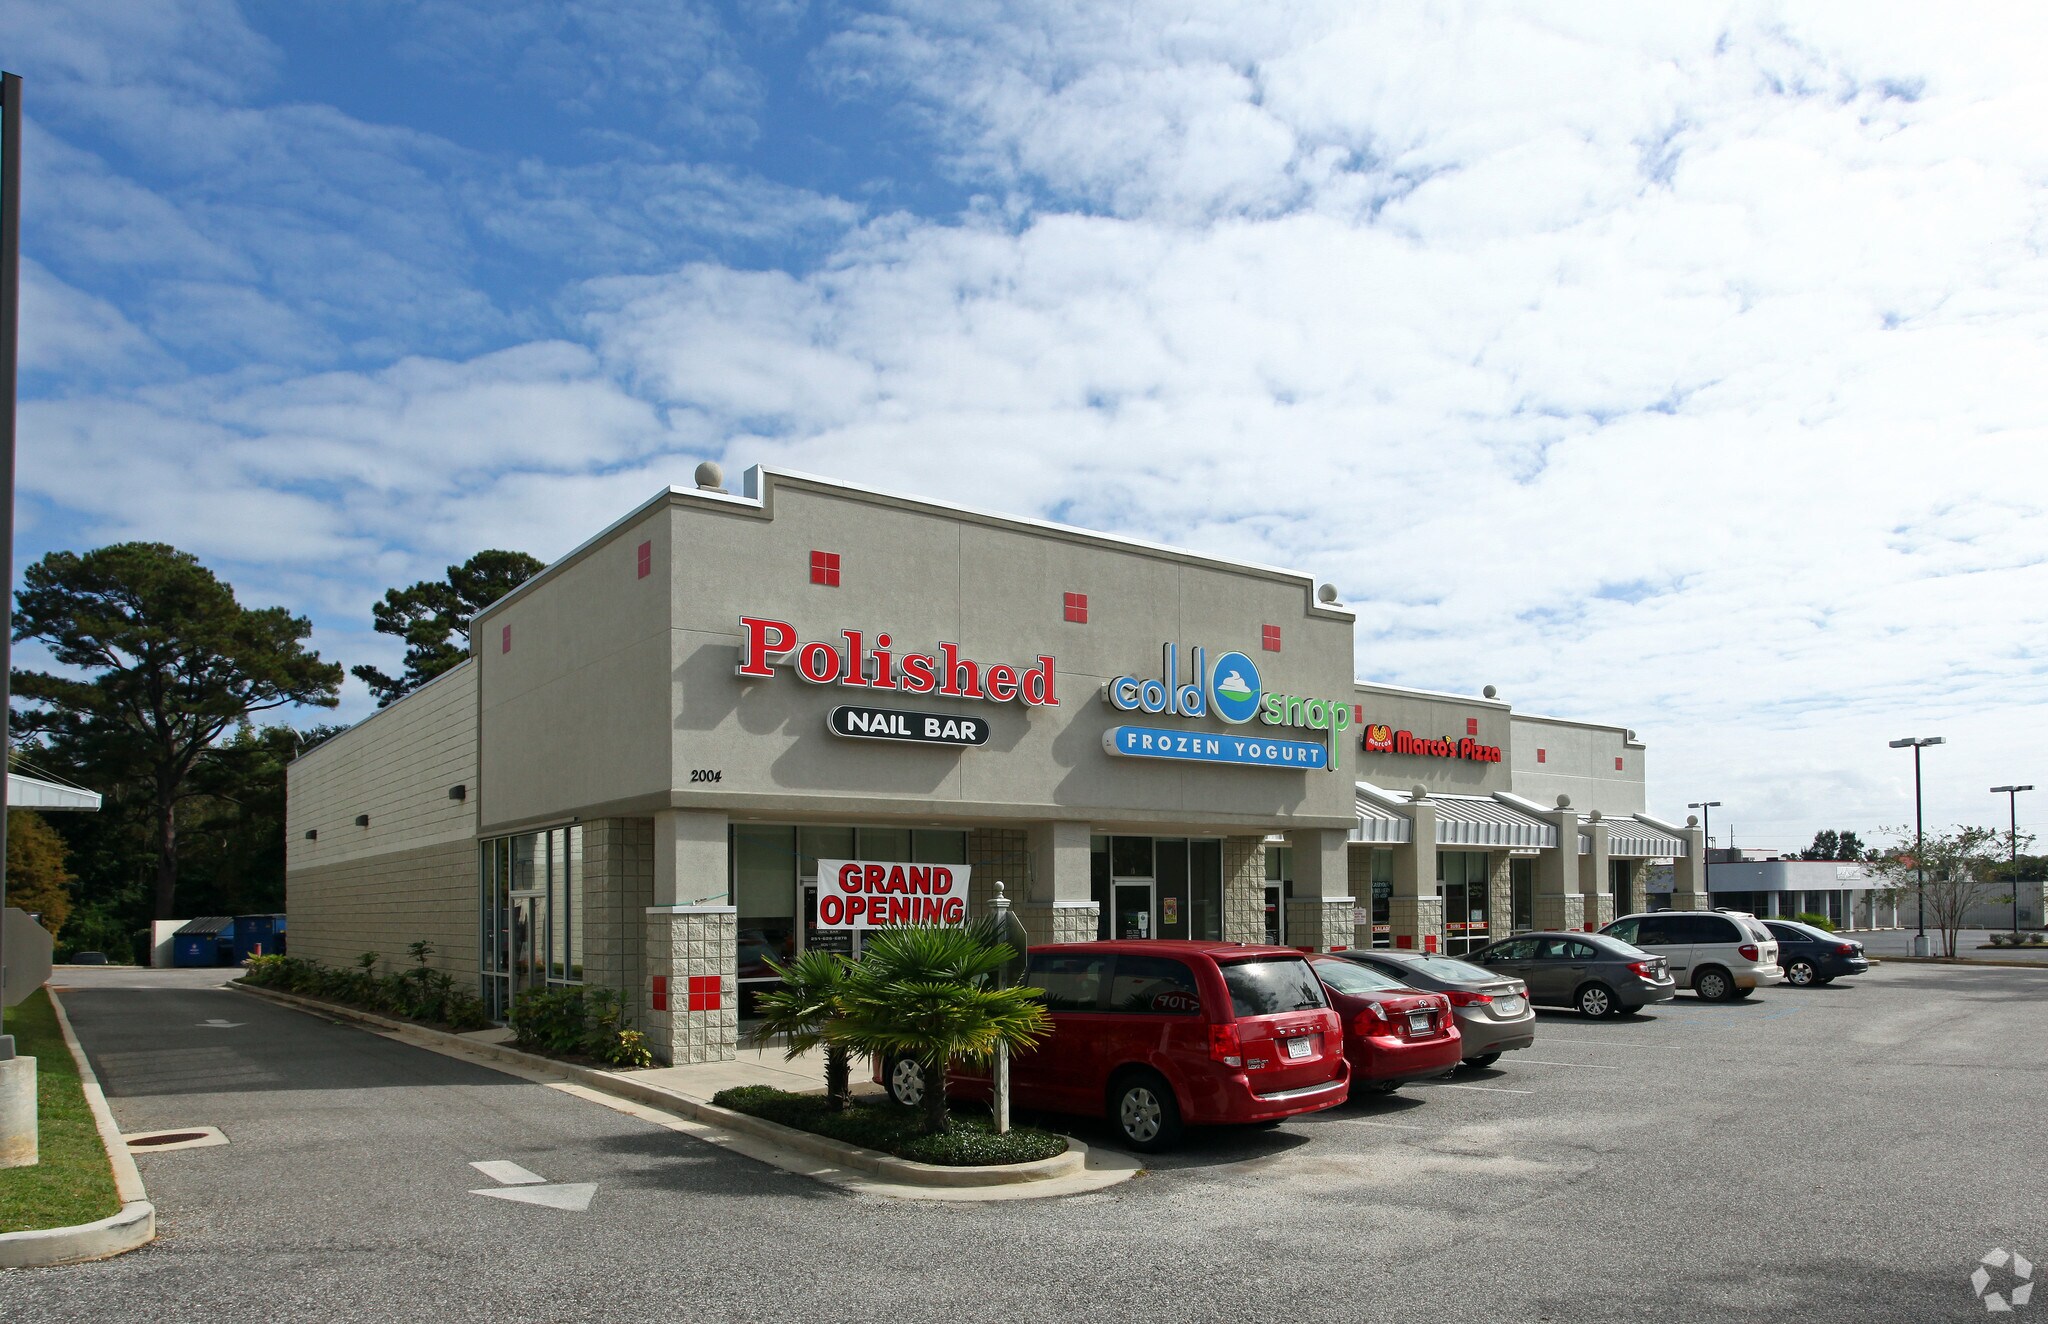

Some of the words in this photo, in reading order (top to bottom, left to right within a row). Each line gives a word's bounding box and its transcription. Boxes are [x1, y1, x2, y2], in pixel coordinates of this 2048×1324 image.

[736, 615, 1061, 707] Polished
[1109, 642, 1206, 718] cold
[1260, 692, 1350, 772] snap
[847, 711, 912, 736] NAIL
[924, 717, 976, 741] BAR
[1127, 733, 1219, 755] FROZEN
[1234, 742, 1319, 763] YOGURT
[1394, 730, 1457, 758] Marco's
[1458, 737, 1501, 763] Pizza
[690, 769, 722, 782] 2004
[838, 863, 953, 895] GRAND
[819, 894, 964, 926] OPENING
